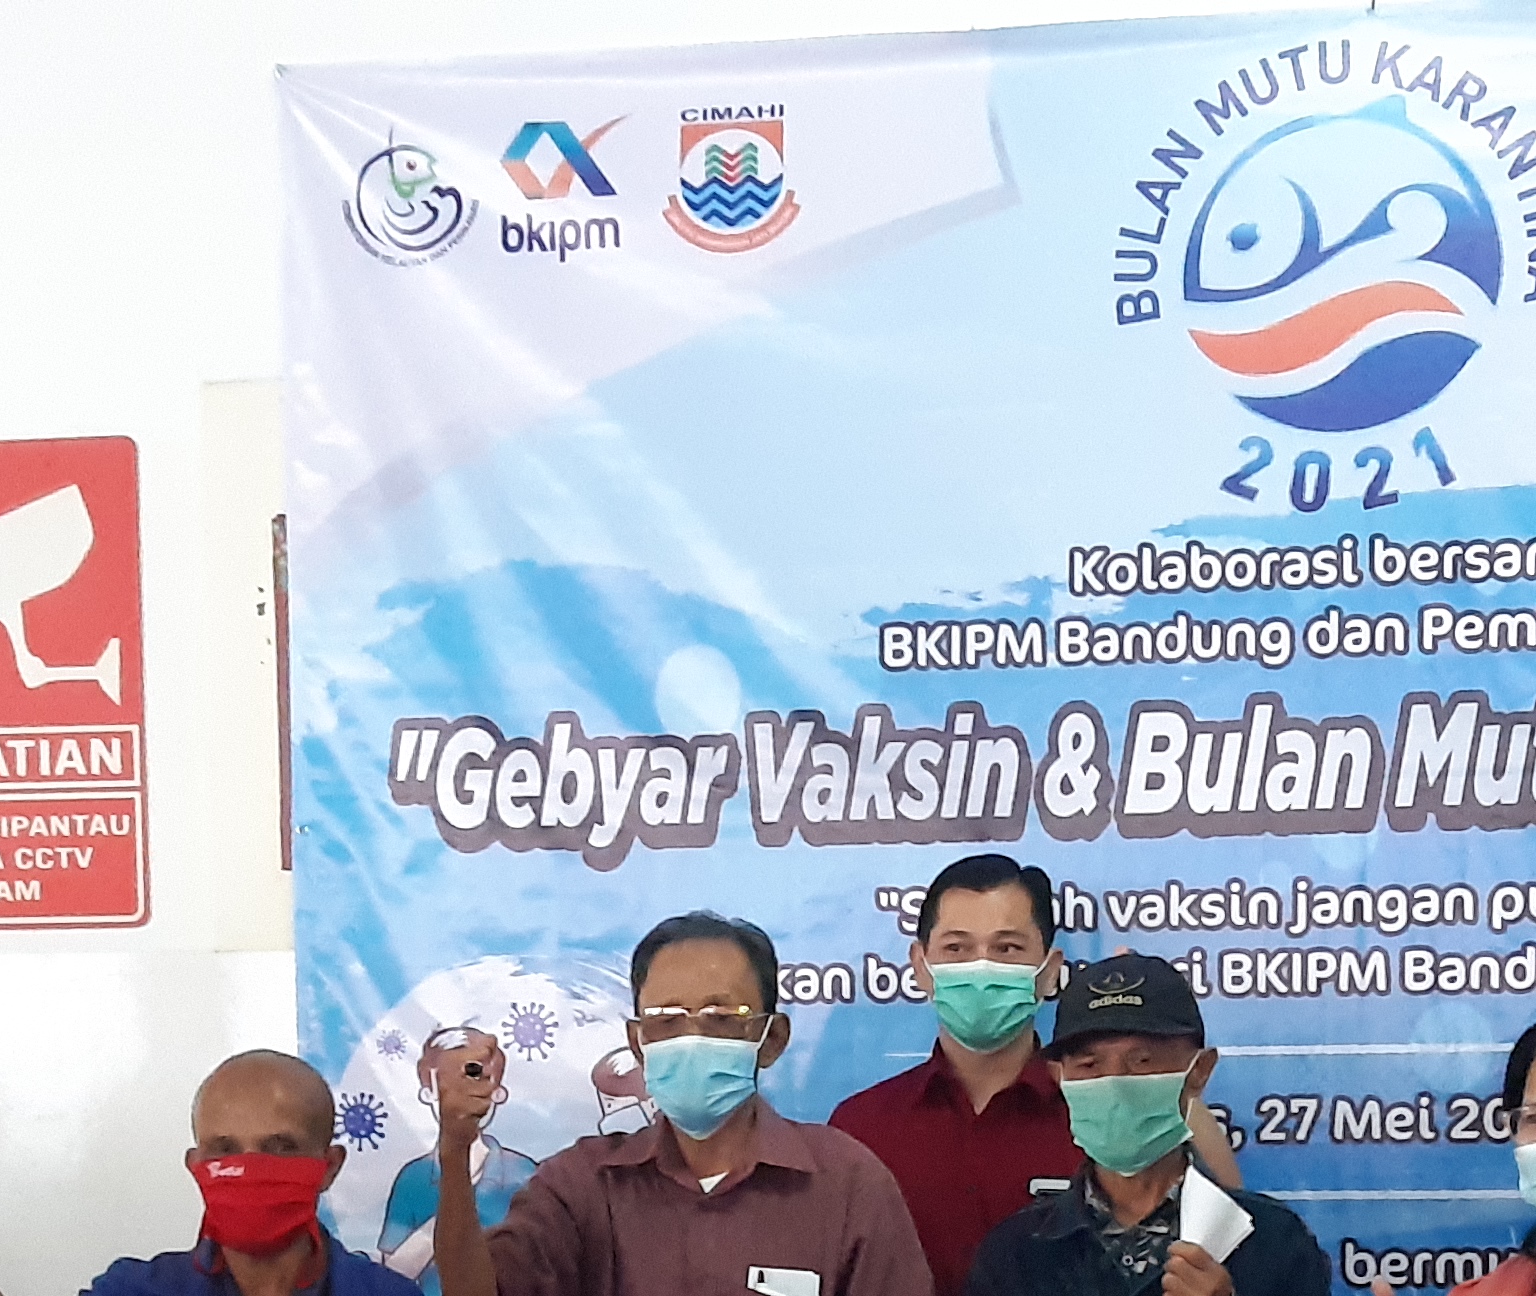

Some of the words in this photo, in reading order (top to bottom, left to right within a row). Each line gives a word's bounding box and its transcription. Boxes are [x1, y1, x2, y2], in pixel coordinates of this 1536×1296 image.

[680, 103, 786, 122] CIMAHI
[1115, 128, 1204, 325] BULAN
[1194, 39, 1351, 136] MUTU
[499, 214, 621, 262] bkipm
[1220, 426, 1457, 513] 2021
[1071, 537, 1360, 593] Kolaborasi
[882, 622, 1047, 667] BKIPM
[1059, 614, 1291, 666] Bandung
[1307, 611, 1405, 656] dan
[396, 714, 728, 848] "Gebyar
[752, 713, 1020, 823] Vaksin
[1042, 711, 1104, 818] &
[1122, 703, 1372, 815] Bulan
[14, 845, 95, 870] CCTV
[1107, 880, 1278, 928] vaksin
[1289, 880, 1474, 935] jangan
[1224, 950, 1388, 996] BKIPM
[1088, 994, 1144, 1010] adidas
[1259, 1097, 1318, 1142] 27
[1332, 1095, 1437, 1141] Mei
